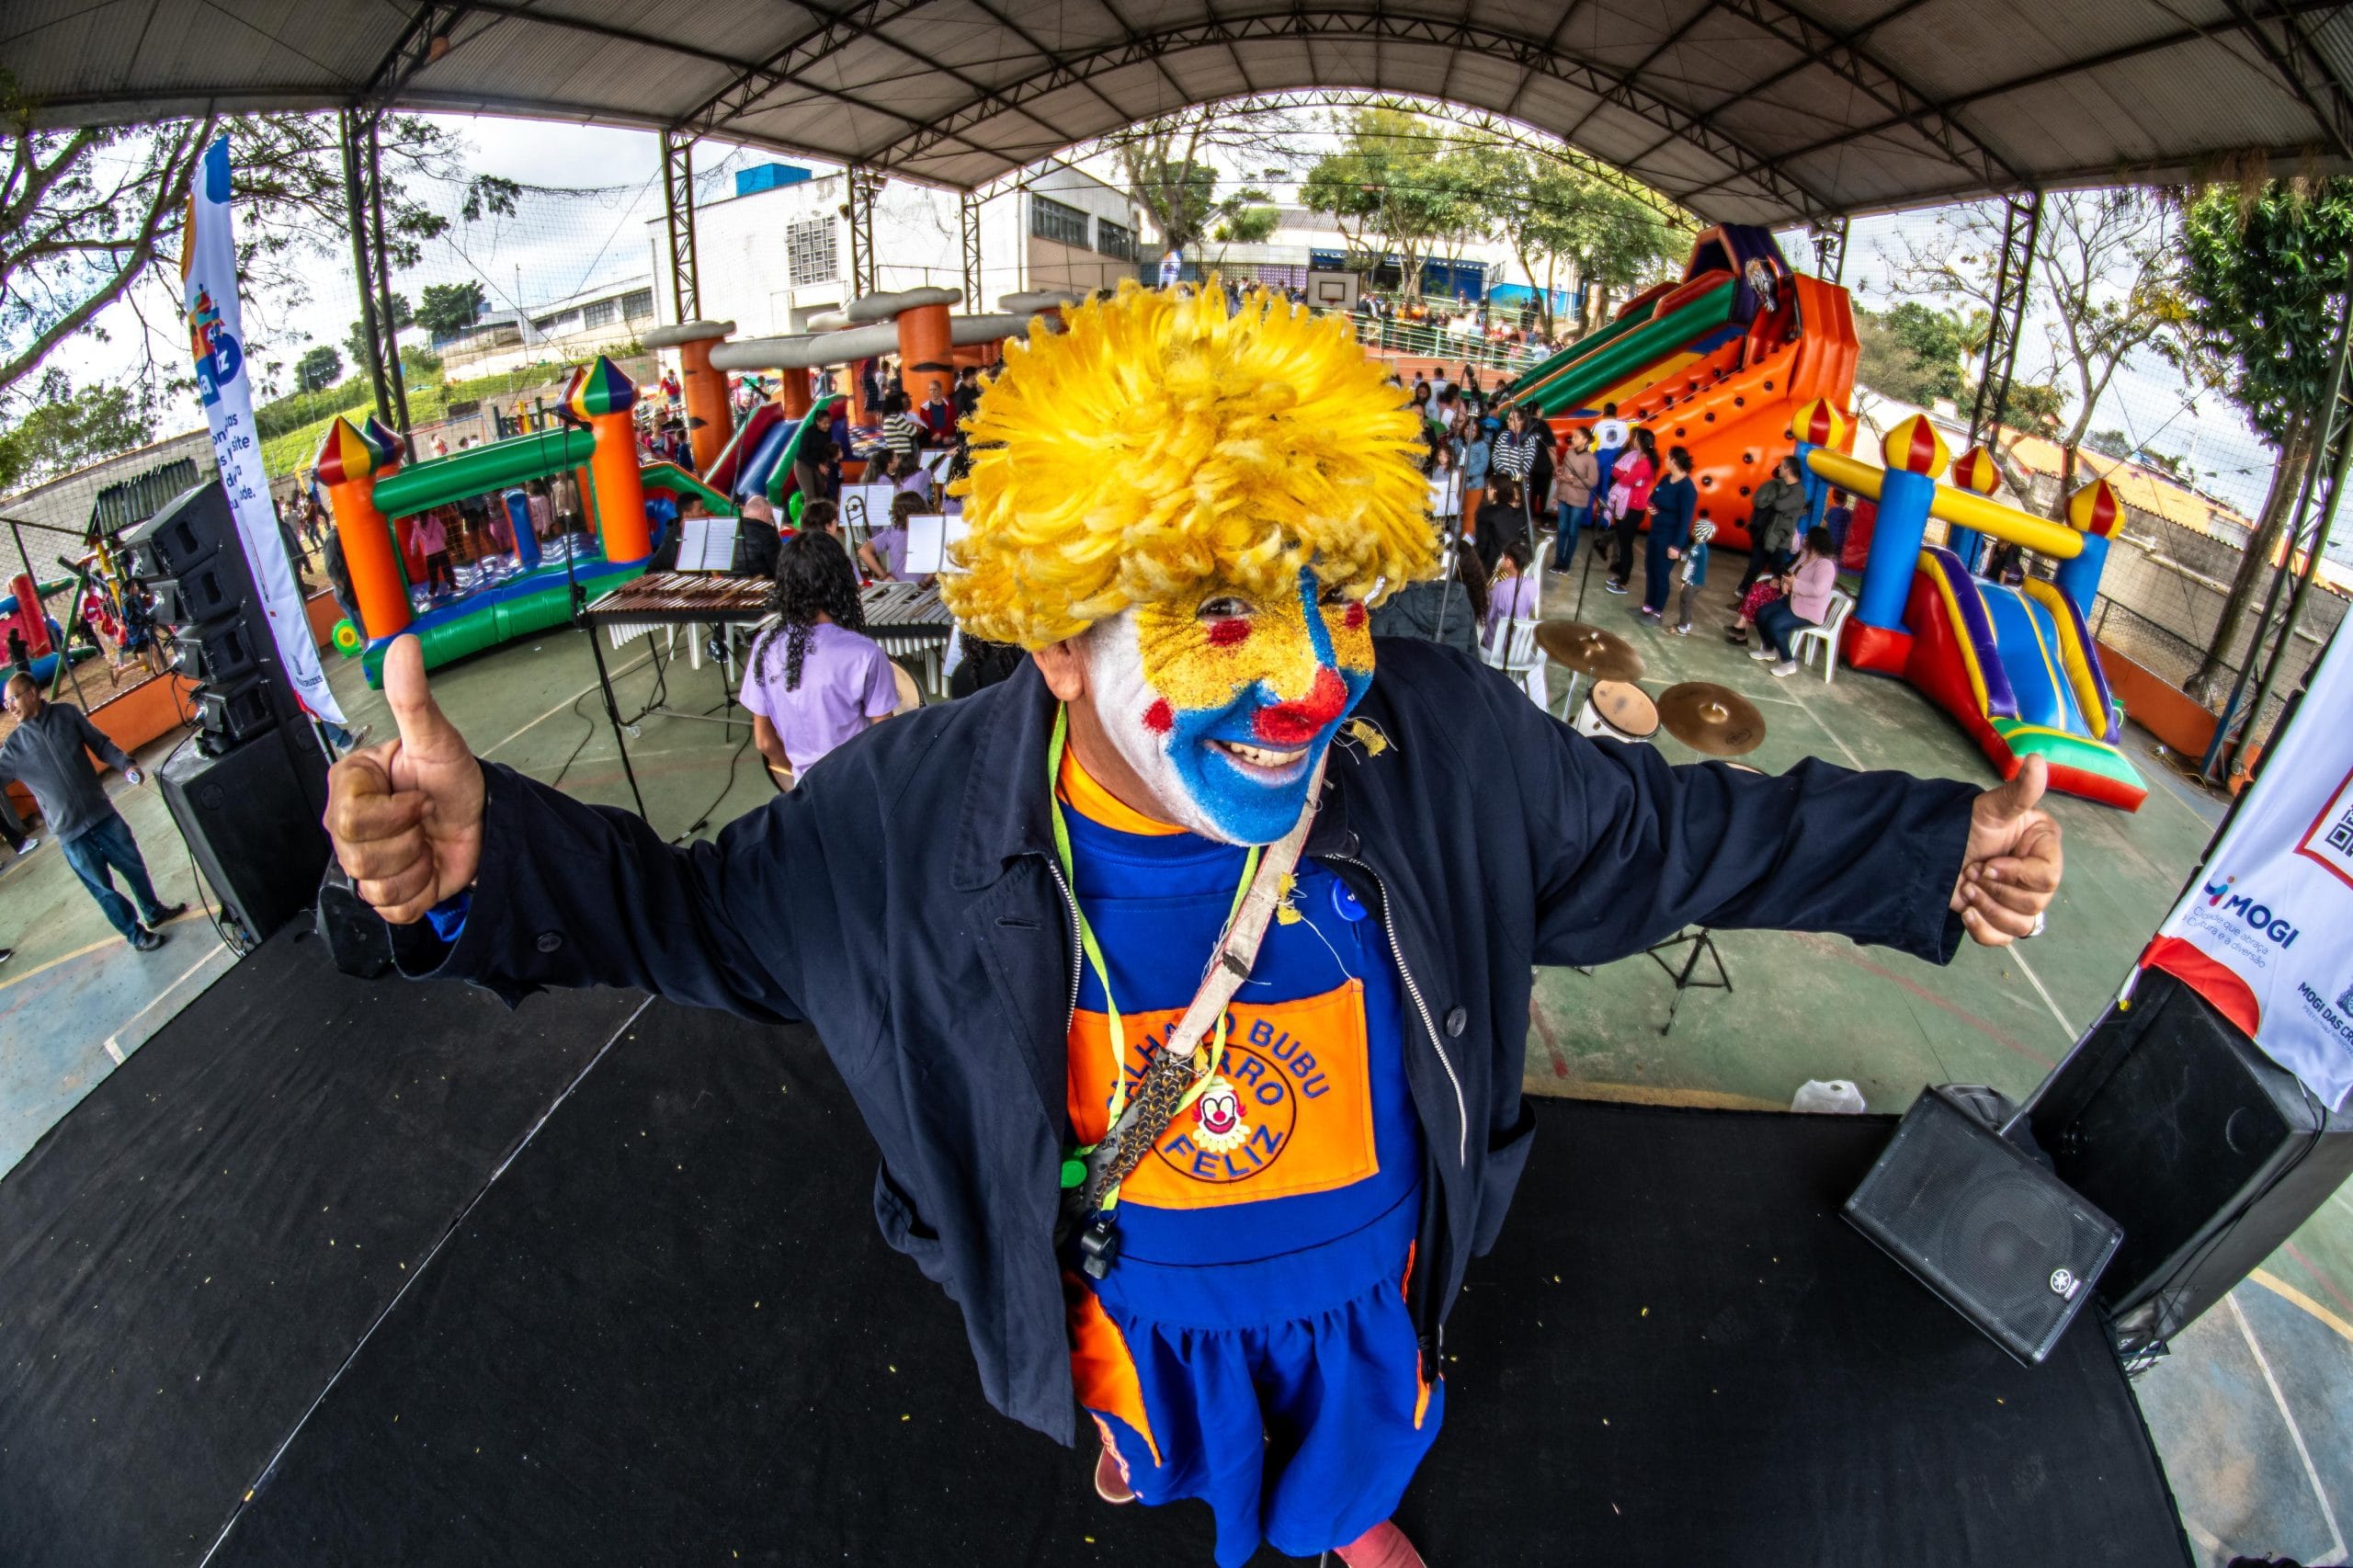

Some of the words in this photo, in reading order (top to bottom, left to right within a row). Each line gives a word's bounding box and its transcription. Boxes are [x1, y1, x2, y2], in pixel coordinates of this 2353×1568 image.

[231, 435, 251, 451] site
[2222, 894, 2300, 949] MOGI
[2223, 921, 2241, 936] que
[2240, 933, 2269, 955] abraça
[2218, 932, 2225, 940] e
[2231, 940, 2266, 969] diversão
[2298, 982, 2325, 1013] MOGI
[2321, 1007, 2344, 1029] DAS
[1248, 1019, 1330, 1100] BUBU
[1164, 1124, 1285, 1179] FELIZ
